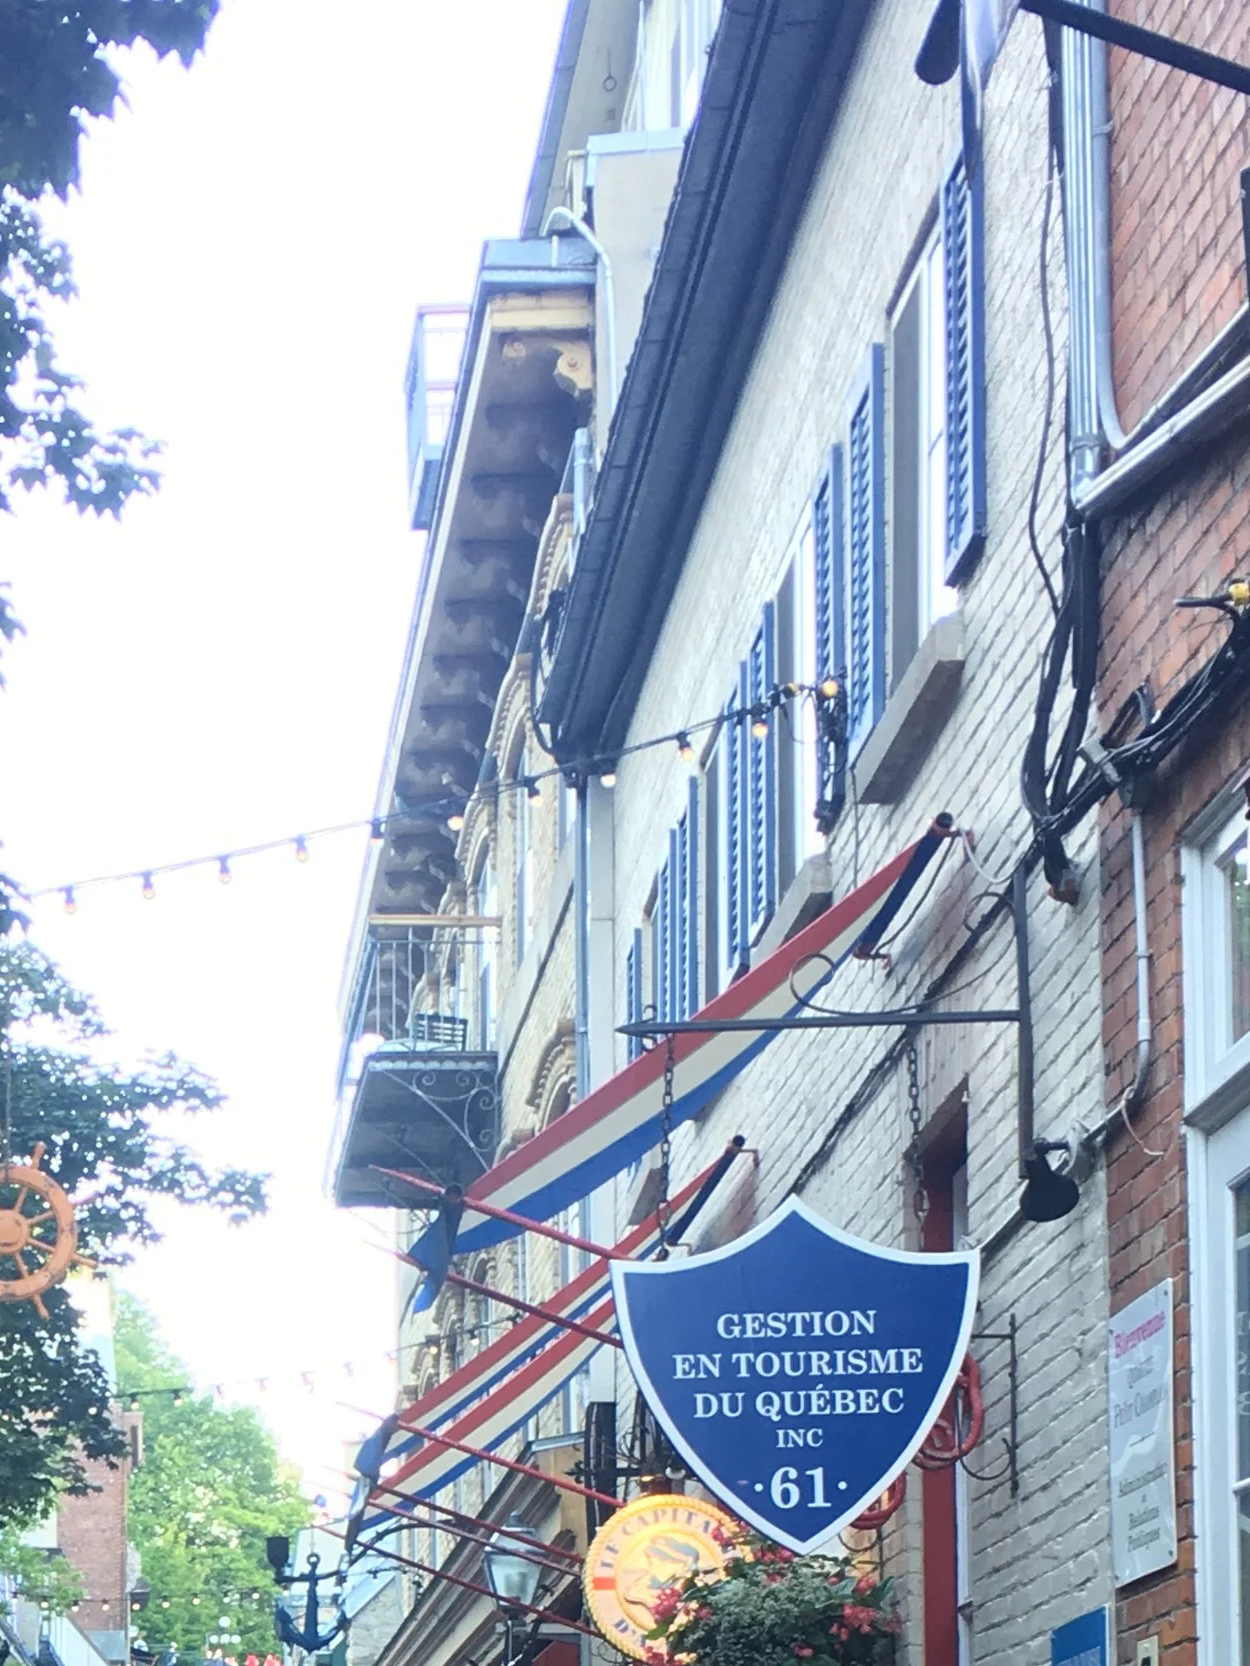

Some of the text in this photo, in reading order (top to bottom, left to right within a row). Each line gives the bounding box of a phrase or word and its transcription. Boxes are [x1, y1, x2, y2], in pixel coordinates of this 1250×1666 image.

[716, 1310, 877, 1340] GESTION
[671, 1348, 924, 1380] EN TOURISME
[693, 1383, 905, 1423] DU QUÉBEC
[775, 1428, 824, 1449] INC
[621, 1507, 713, 1537] CAPITA
